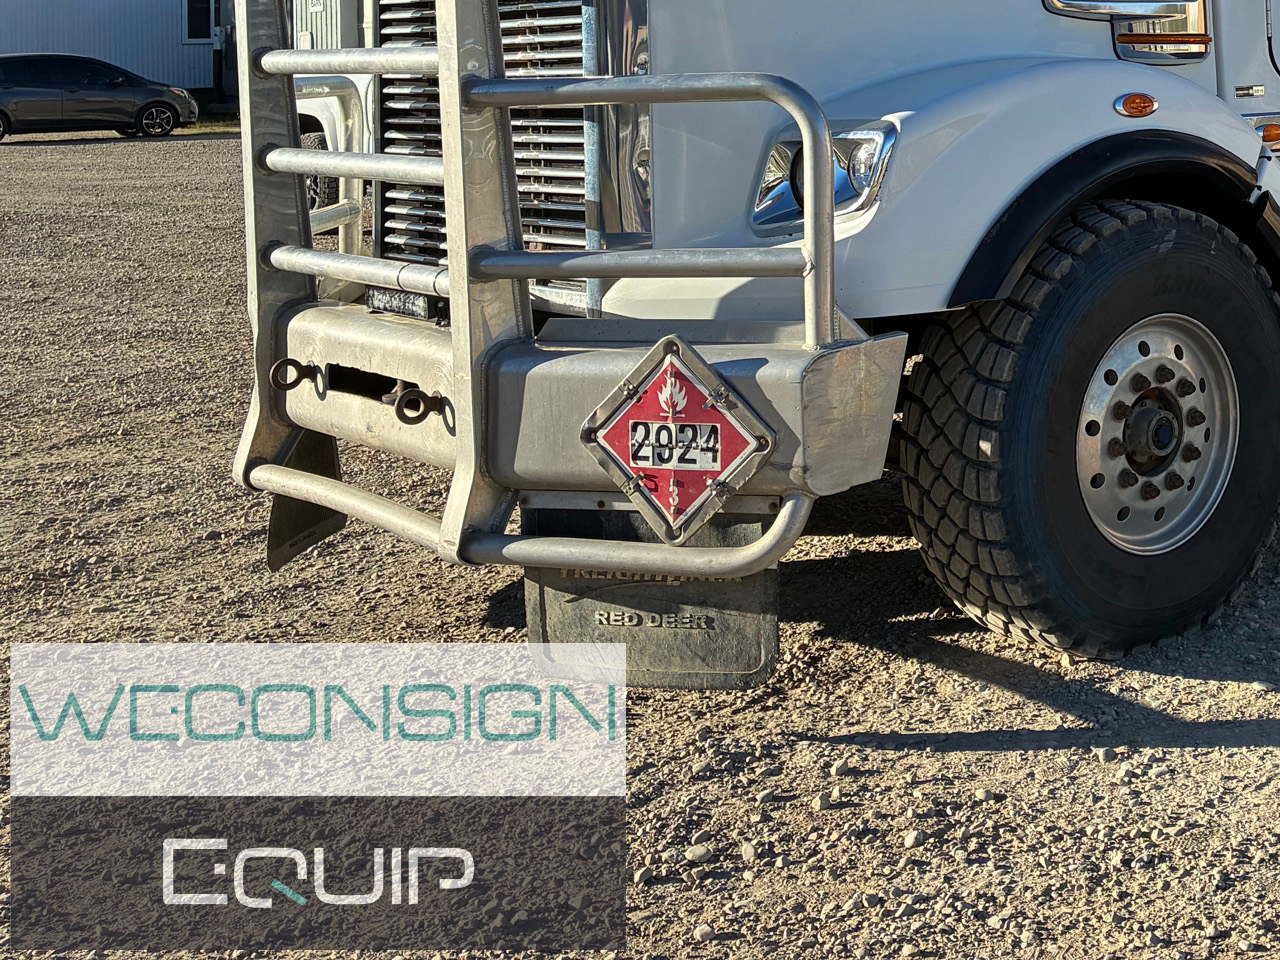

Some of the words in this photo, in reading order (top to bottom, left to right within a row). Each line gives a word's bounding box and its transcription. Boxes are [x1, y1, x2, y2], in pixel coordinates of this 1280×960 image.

[630, 421, 719, 465] 2924
[668, 485, 680, 506] 3
[594, 610, 640, 626] RED
[646, 612, 710, 629] DEER
